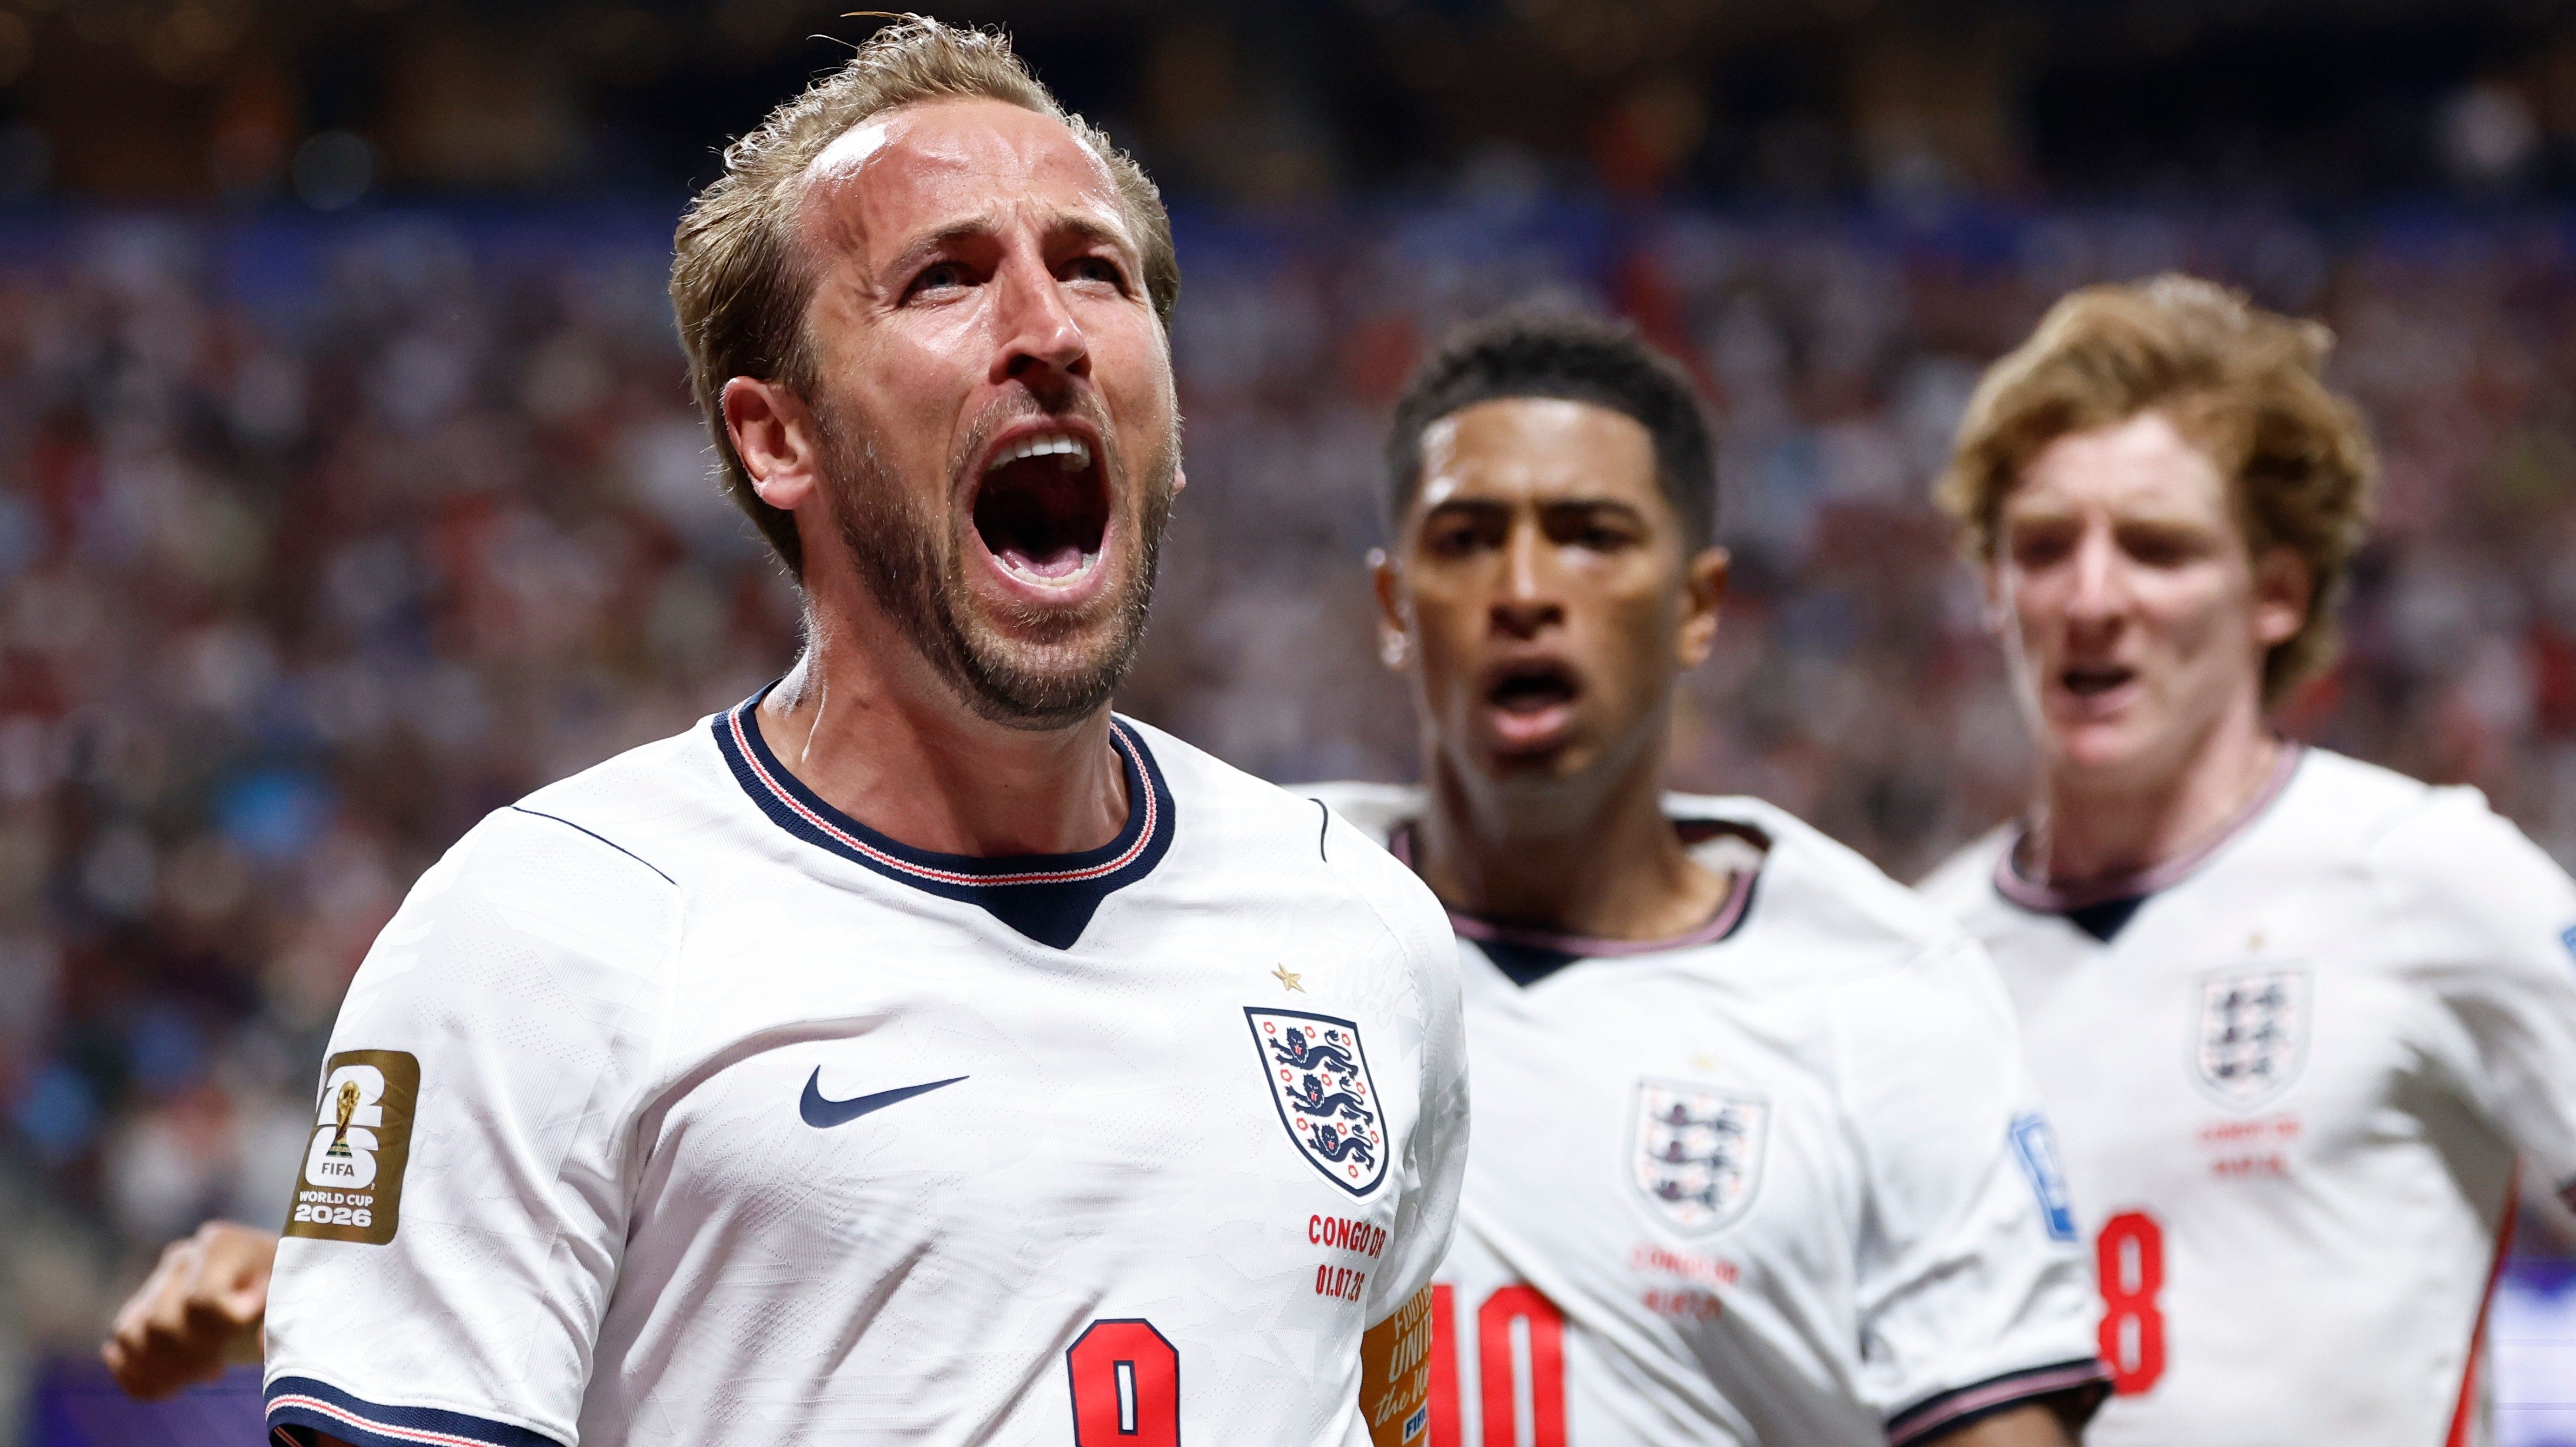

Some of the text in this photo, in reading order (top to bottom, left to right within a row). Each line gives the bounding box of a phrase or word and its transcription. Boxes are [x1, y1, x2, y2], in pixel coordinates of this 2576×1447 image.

[321, 1162, 355, 1177] FIFA
[294, 1203, 372, 1227] 2026
[299, 1191, 374, 1206] WORLD CUP
[1309, 1214, 1386, 1259] CONGO DR
[1316, 1264, 1365, 1302] 01.07.26
[2097, 1211, 2165, 1396] 8
[1389, 1308, 1432, 1383] UNIT
[1373, 1384, 1410, 1428] the
